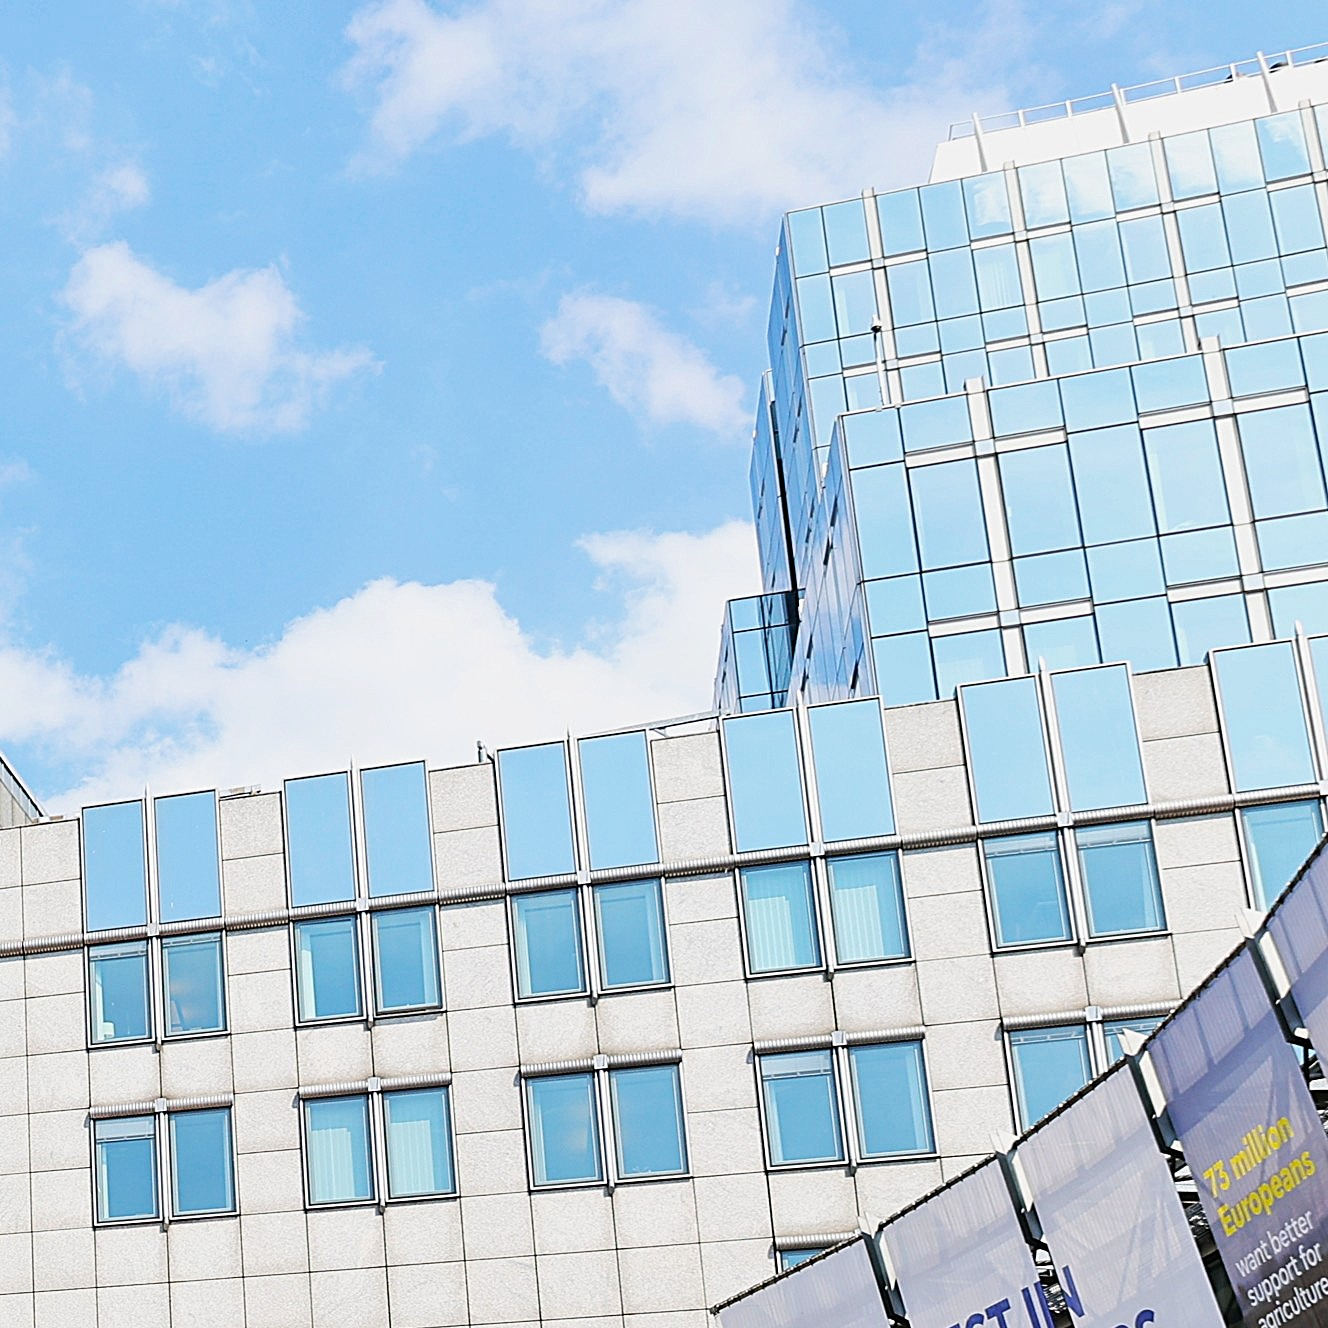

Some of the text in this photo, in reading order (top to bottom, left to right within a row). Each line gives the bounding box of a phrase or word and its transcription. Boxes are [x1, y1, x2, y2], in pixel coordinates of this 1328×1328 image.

[1203, 1117, 1295, 1198] 73 million
[1217, 1151, 1316, 1237] Europeans
[1235, 1210, 1314, 1278] want better
[1247, 1243, 1323, 1307] support for
